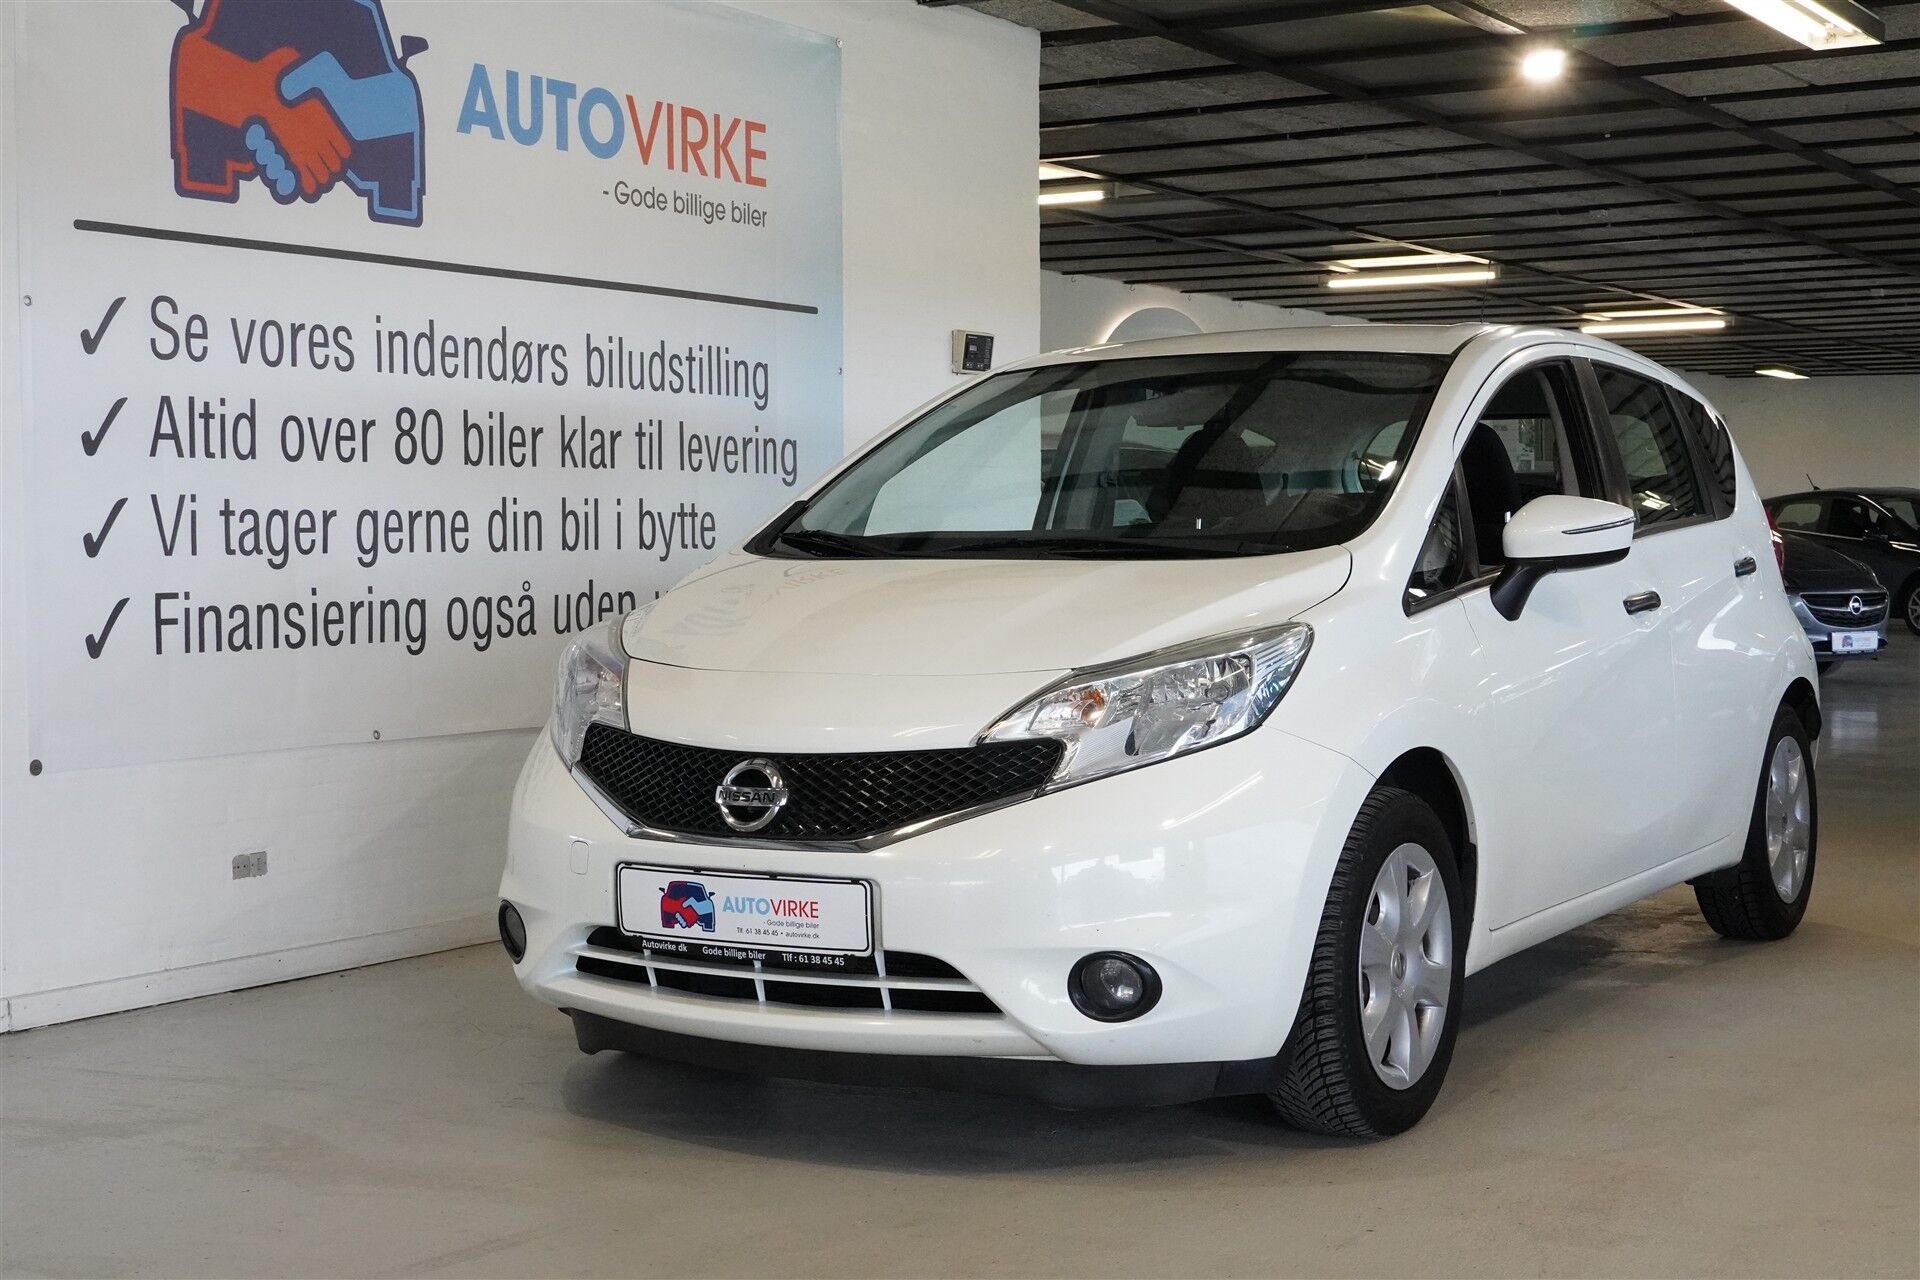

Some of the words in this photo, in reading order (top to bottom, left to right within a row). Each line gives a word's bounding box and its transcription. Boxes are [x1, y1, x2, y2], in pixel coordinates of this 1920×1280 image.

[456, 63, 767, 188] AUTOVIRKE
[614, 180, 668, 212] Gode
[673, 190, 727, 225] billige
[731, 200, 768, 228] biler
[149, 294, 209, 363] Se
[230, 317, 355, 373] vores
[375, 314, 570, 388] indendørs
[585, 332, 770, 412] biludstilling
[149, 395, 257, 461] Altid
[280, 413, 377, 465] over
[394, 406, 445, 467] 80
[462, 408, 544, 470] biler
[560, 414, 622, 472] klar
[635, 418, 663, 472] til
[678, 420, 798, 488] levering
[150, 493, 198, 557] Vi
[218, 497, 338, 571] tager
[356, 507, 470, 571] gerne
[487, 496, 543, 554] din
[561, 496, 600, 553] bil
[616, 497, 623, 551] i
[638, 497, 717, 564] bytte
[154, 585, 427, 656] Finansiering
[446, 580, 538, 655] også
[719, 787, 776, 803] NISSAN
[722, 895, 820, 919] AUTOVIRKE
[766, 919, 785, 928] Gode
[785, 920, 805, 930] billige
[805, 922, 820, 930] biler
[641, 940, 677, 952] Autovirke
[702, 946, 723, 956] Gode
[723, 948, 747, 960] billige
[748, 950, 767, 960] biler
[799, 954, 809, 963] 61
[810, 955, 821, 964] 38
[822, 956, 833, 965] 45
[834, 957, 845, 966] 45
